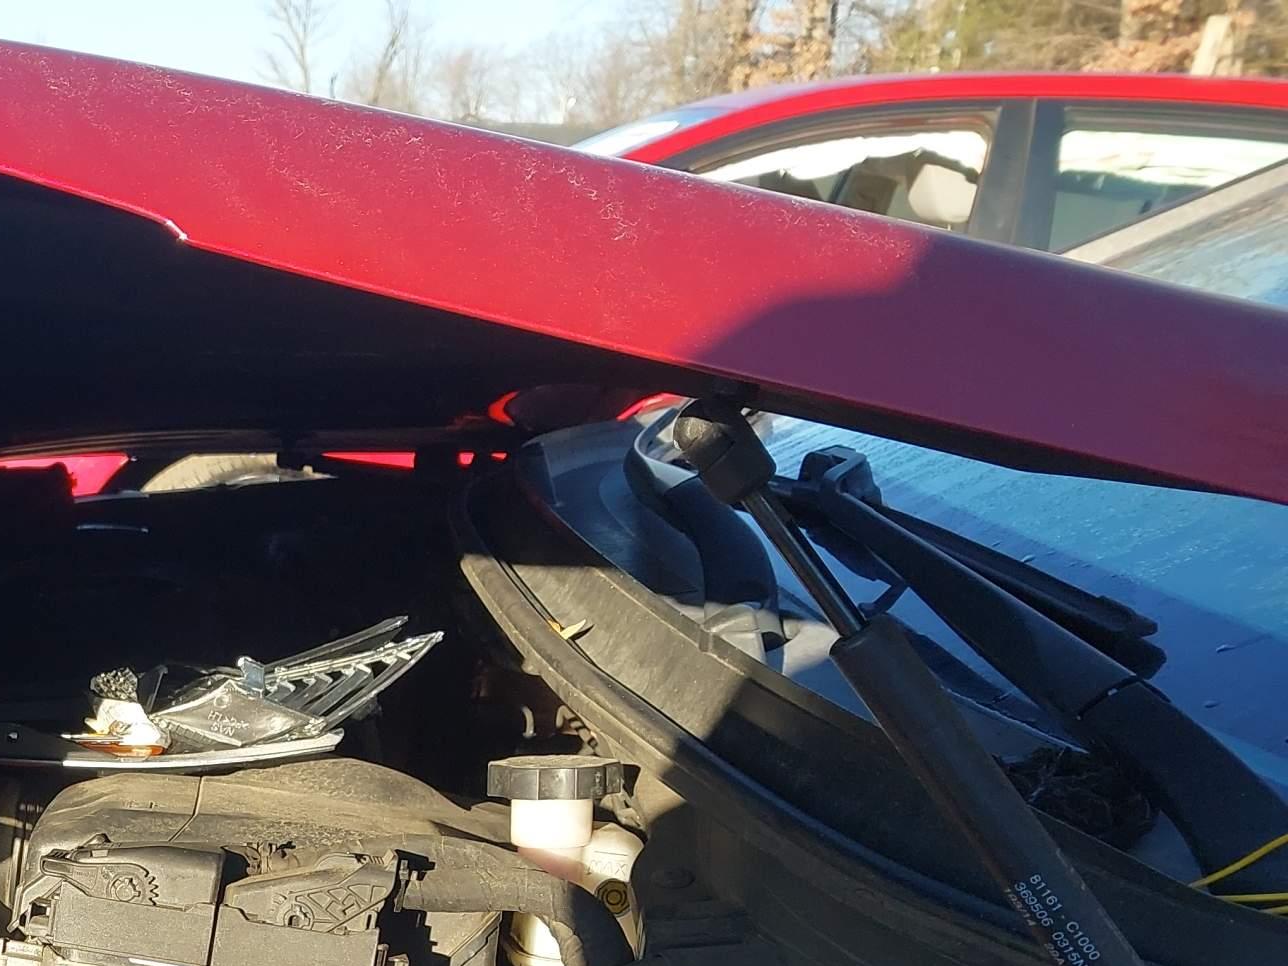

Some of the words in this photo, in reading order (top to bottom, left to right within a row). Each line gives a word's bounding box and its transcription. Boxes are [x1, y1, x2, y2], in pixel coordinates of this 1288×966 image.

[1014, 882, 1054, 927] 369506
[1029, 874, 1063, 912] 81161
[1066, 921, 1100, 961] C1000
